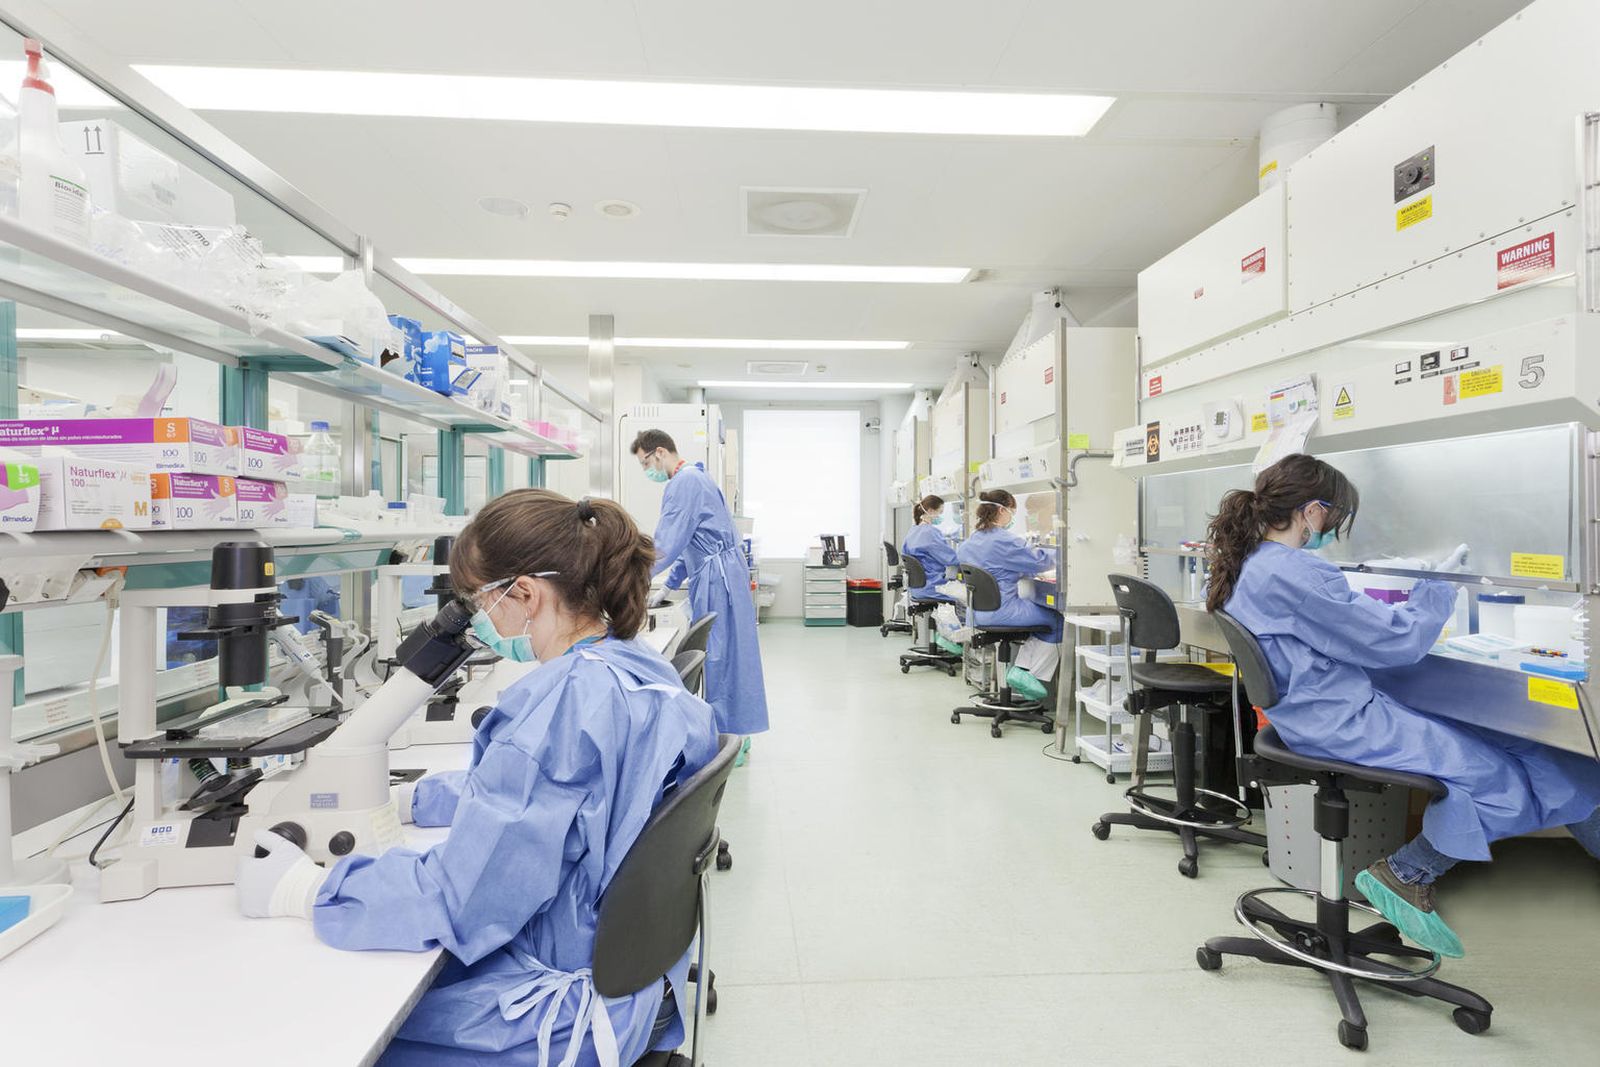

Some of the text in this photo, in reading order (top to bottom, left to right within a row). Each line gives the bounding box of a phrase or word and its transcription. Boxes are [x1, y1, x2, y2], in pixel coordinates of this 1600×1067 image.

[1501, 238, 1550, 265] WARNING
[1518, 354, 1546, 389] 5
[166, 422, 176, 433] S
[162, 449, 179, 457] 100
[247, 457, 263, 469] 100
[70, 466, 116, 479] Naturflex
[70, 478, 86, 488] 100
[134, 500, 148, 516] M
[176, 507, 193, 518] 100
[240, 509, 254, 519] 100
